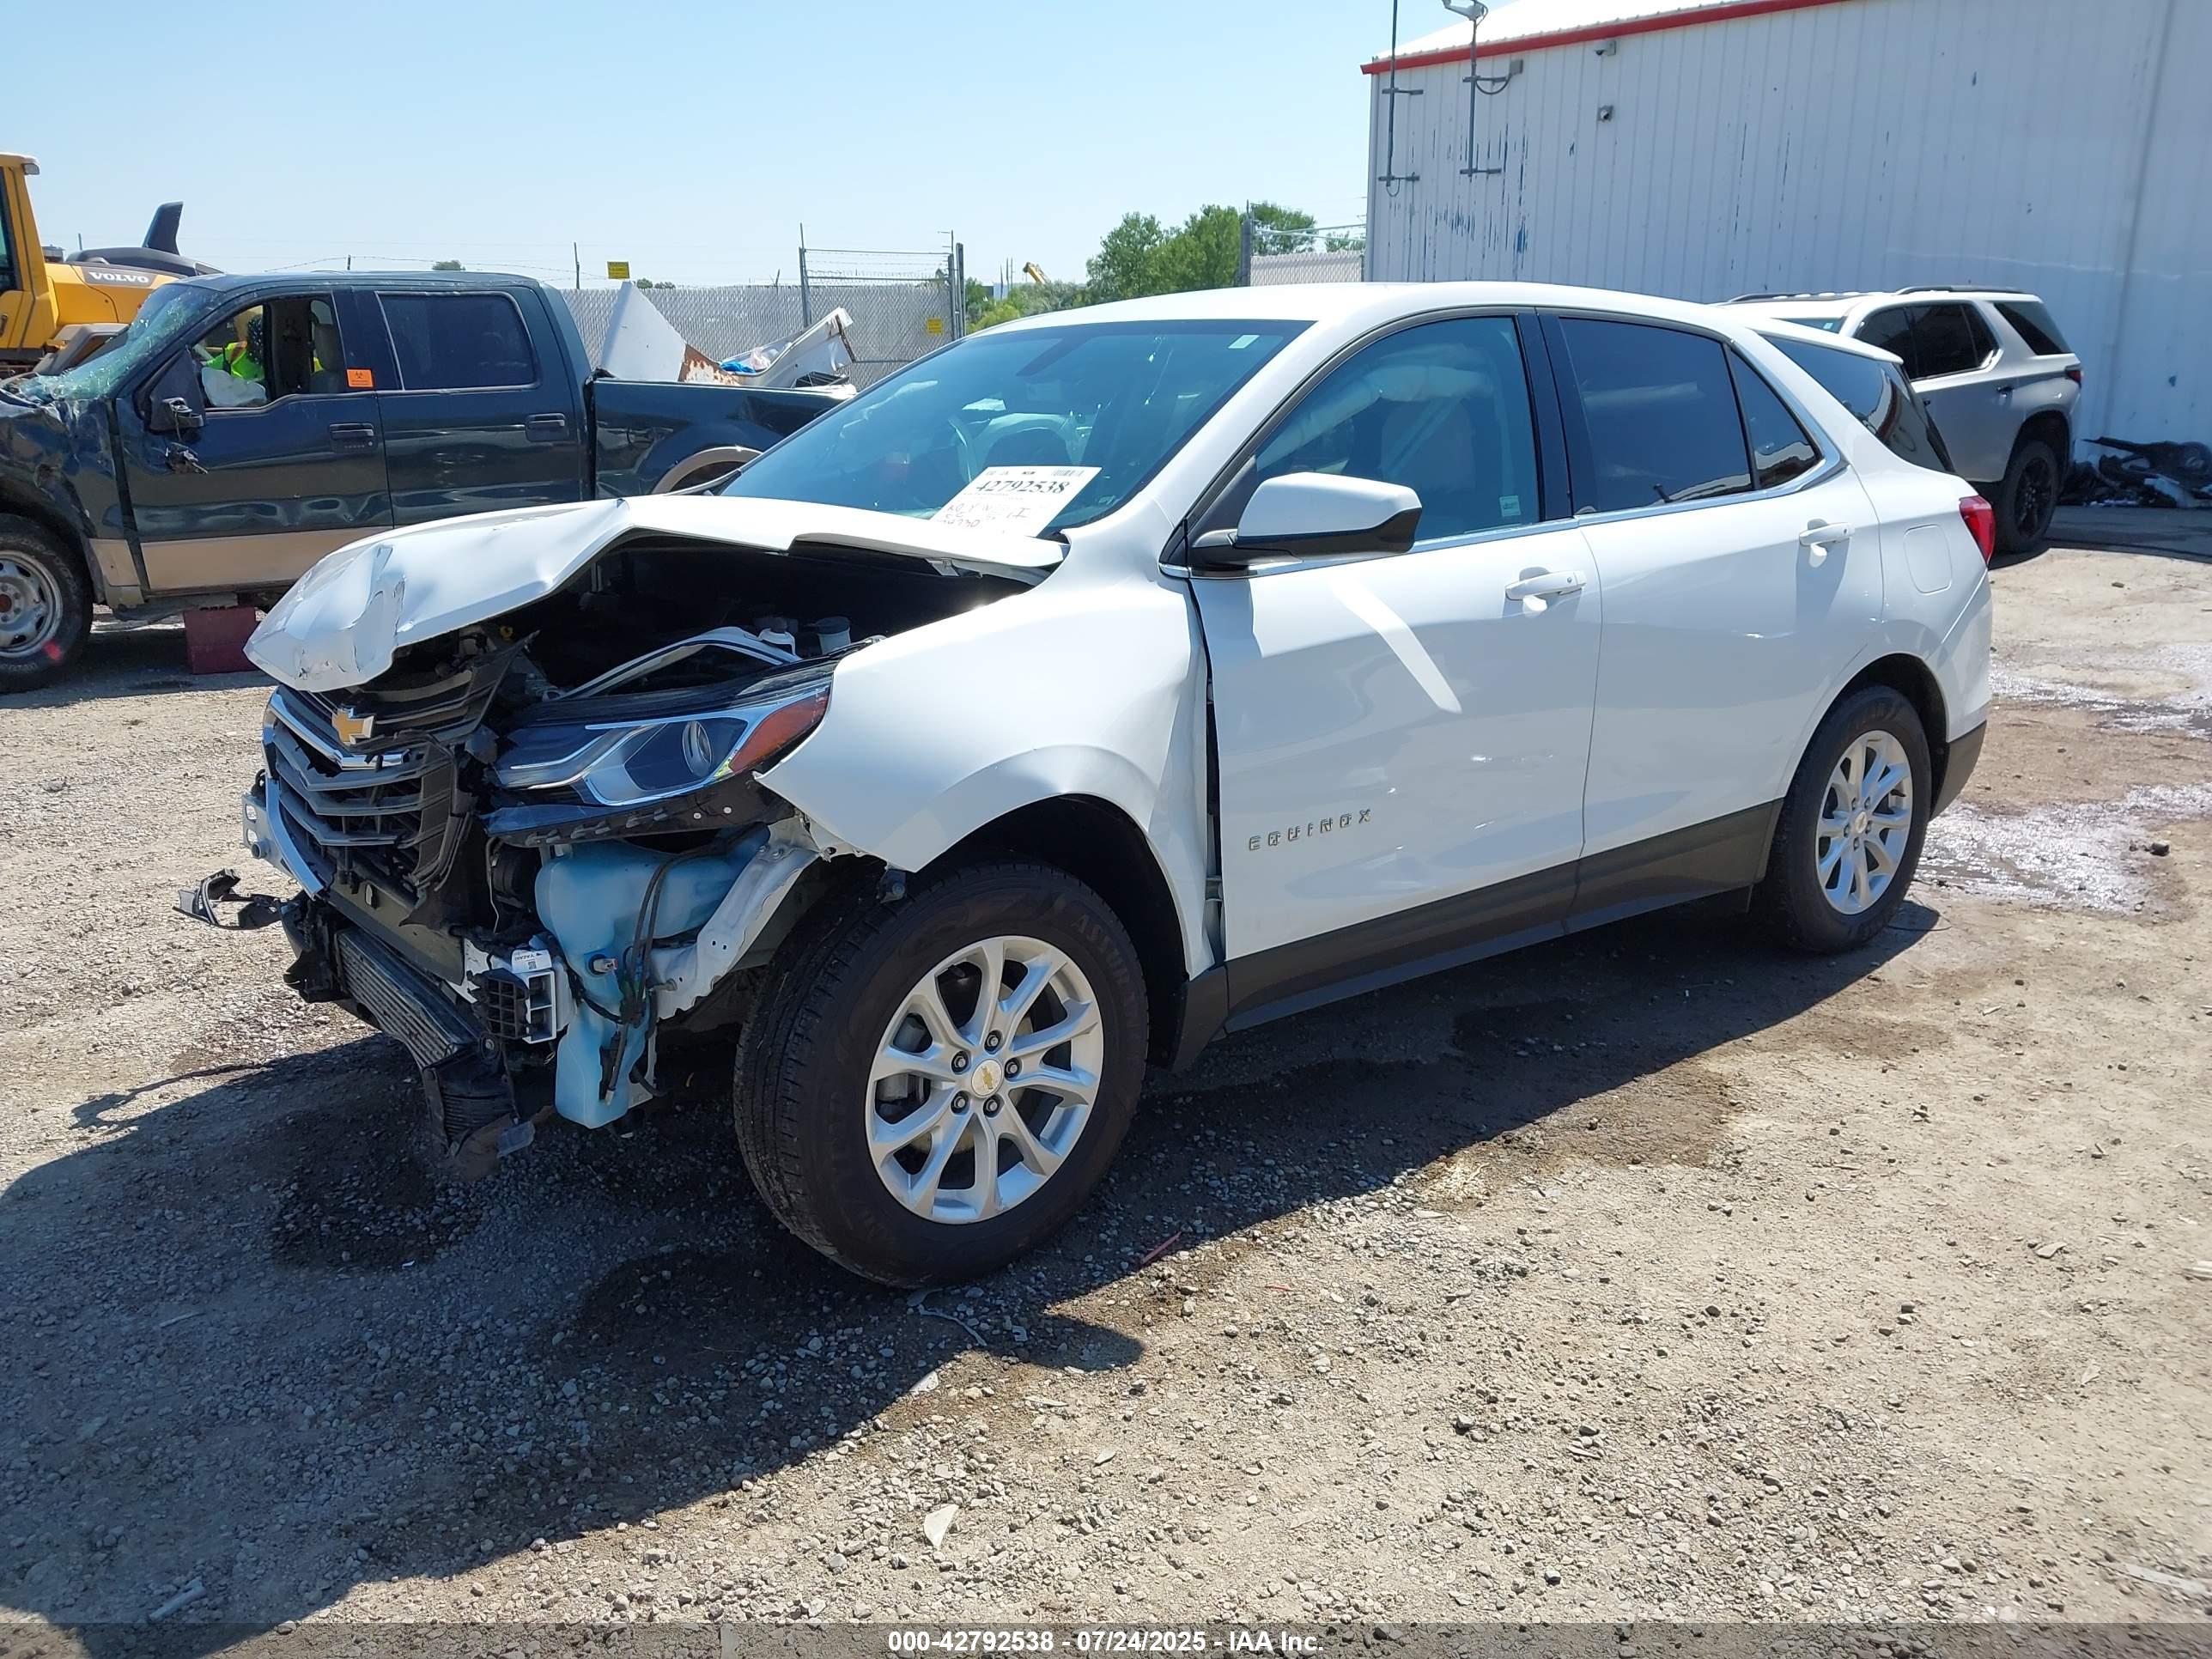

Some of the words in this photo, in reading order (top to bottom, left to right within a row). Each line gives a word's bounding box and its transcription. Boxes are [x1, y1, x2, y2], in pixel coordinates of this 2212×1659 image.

[88, 271, 149, 283] VOLVO
[976, 480, 1070, 494] 42792538
[1249, 808, 1371, 851] EQUINOX
